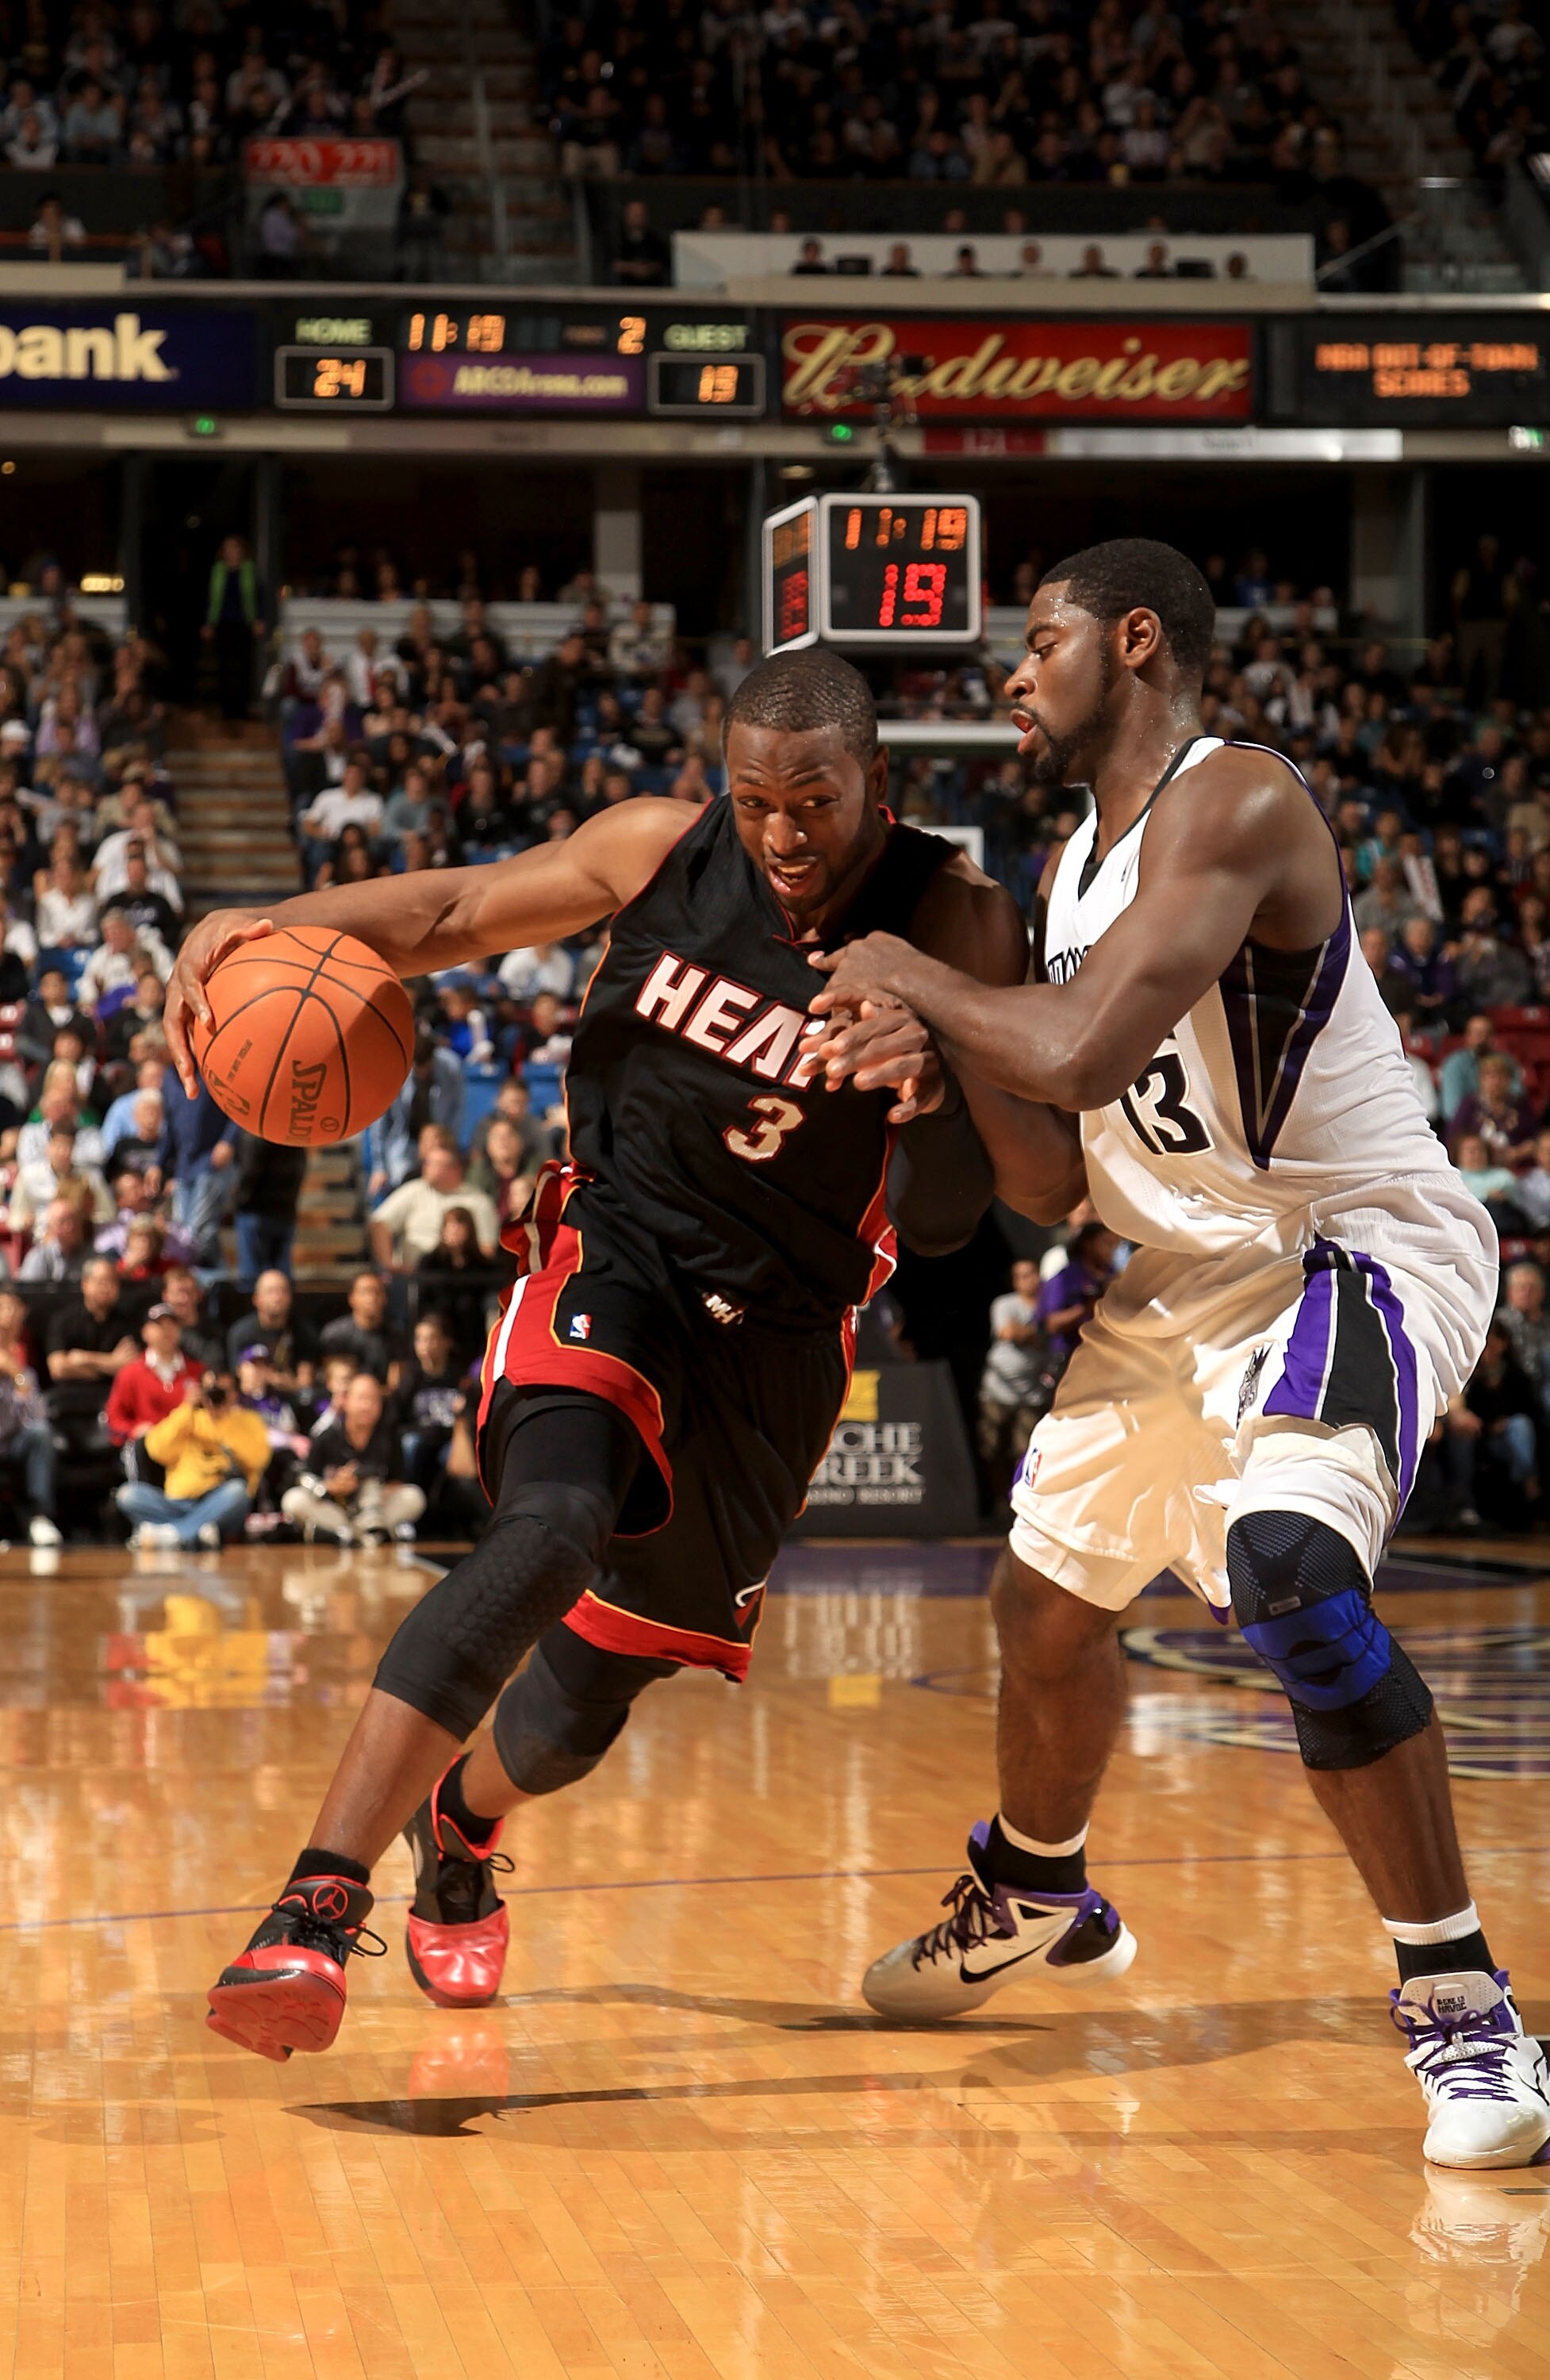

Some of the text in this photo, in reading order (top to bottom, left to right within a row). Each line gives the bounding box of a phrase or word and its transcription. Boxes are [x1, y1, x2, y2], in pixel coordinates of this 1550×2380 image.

[295, 318, 372, 345] HOME
[617, 317, 646, 355] 2
[664, 324, 750, 351] GUEST
[313, 358, 367, 397] 24
[845, 508, 967, 551] 11:19
[879, 563, 947, 627] 19
[723, 1094, 807, 1163] 3
[828, 1422, 923, 1454] CHE
